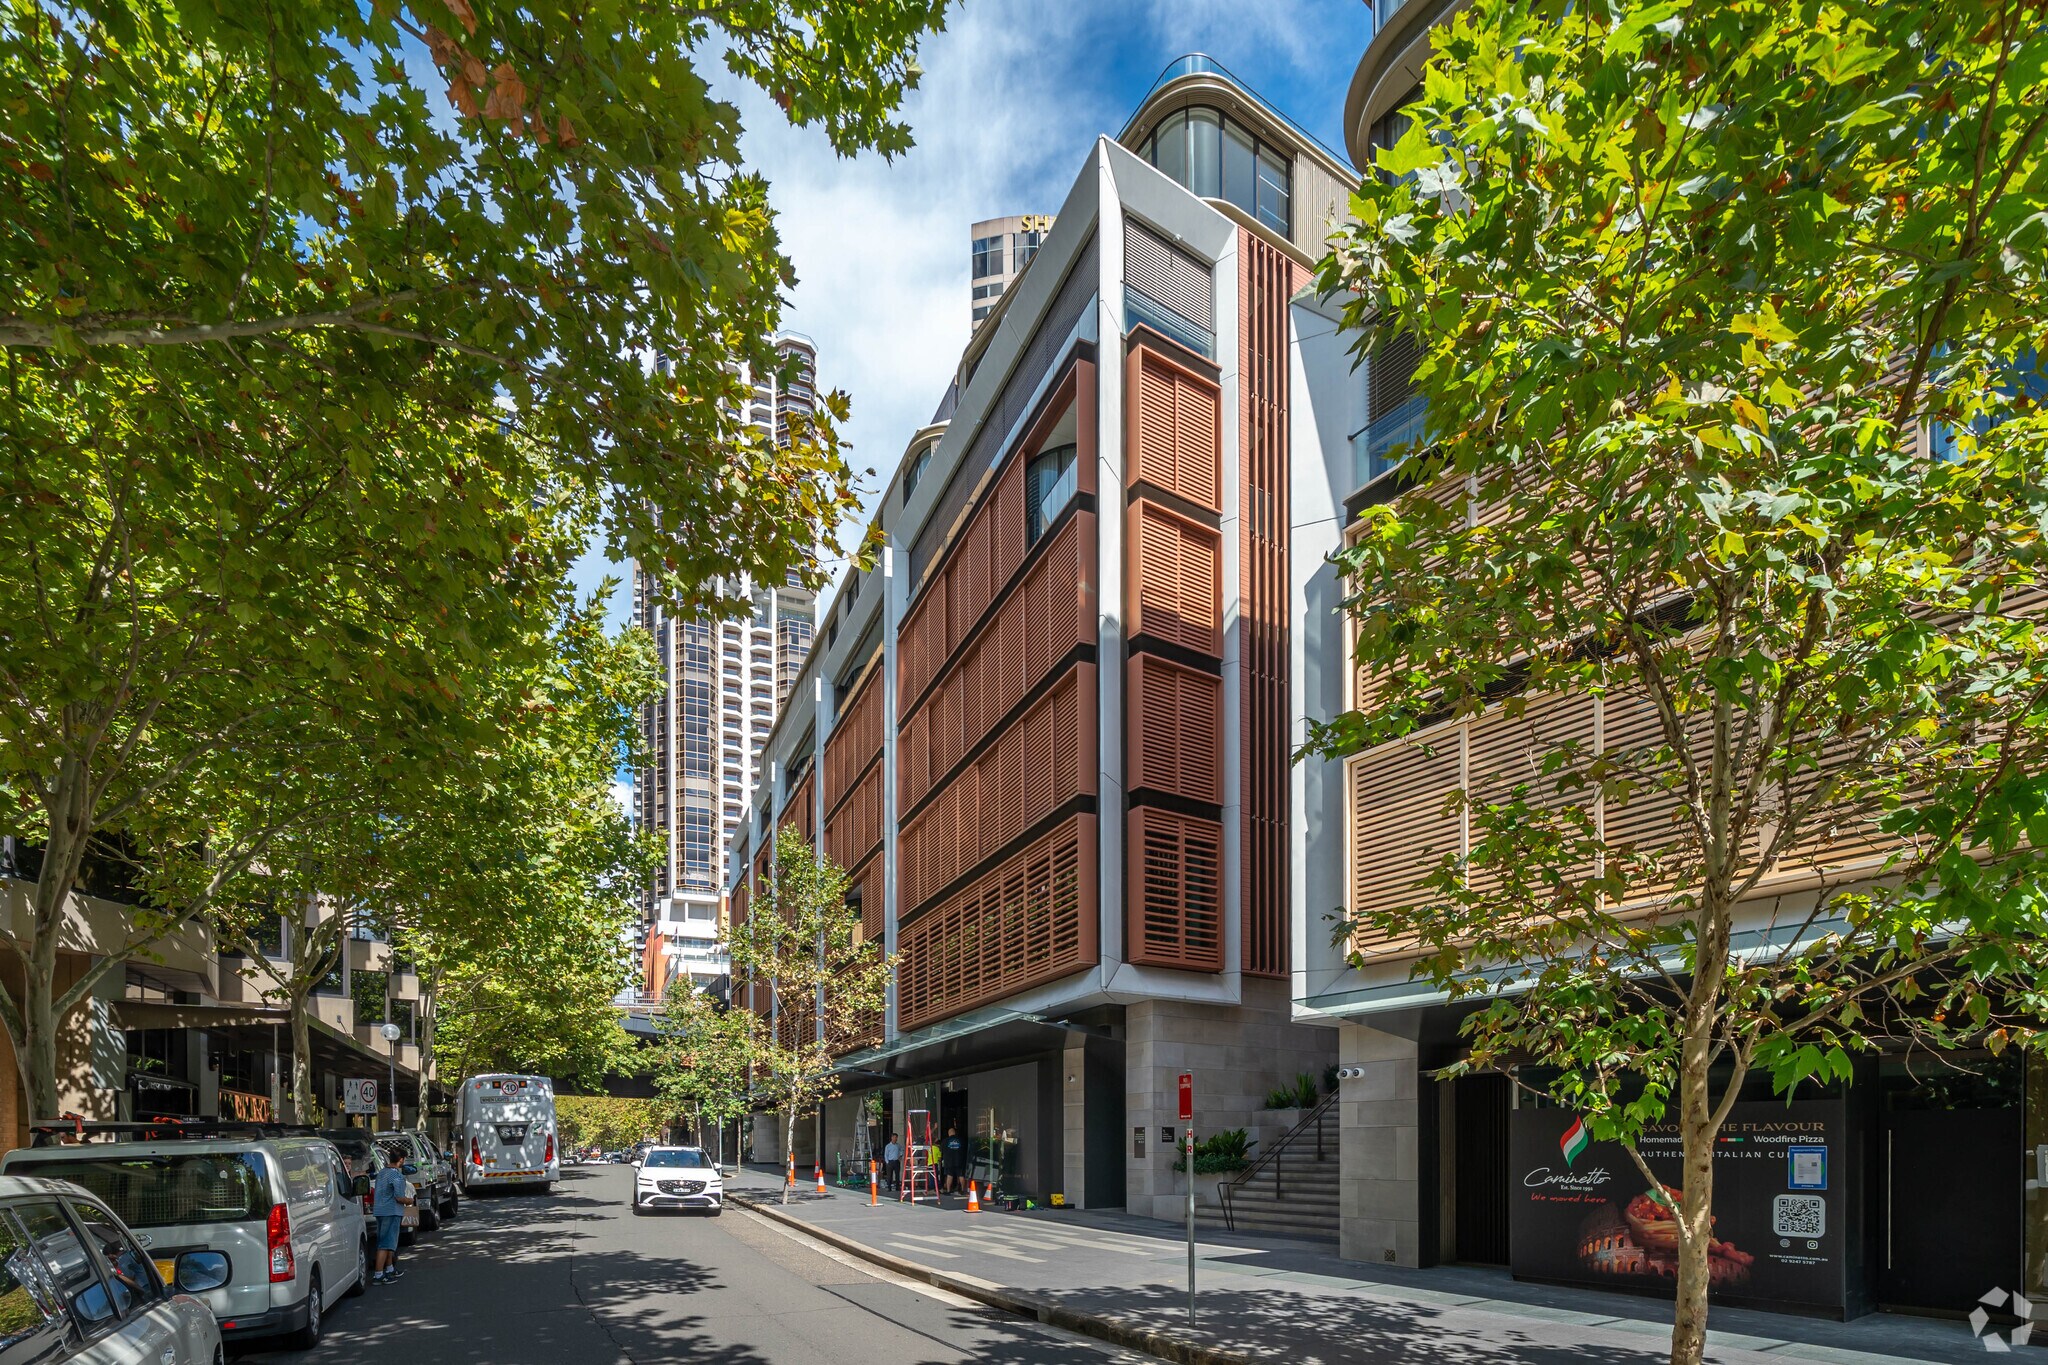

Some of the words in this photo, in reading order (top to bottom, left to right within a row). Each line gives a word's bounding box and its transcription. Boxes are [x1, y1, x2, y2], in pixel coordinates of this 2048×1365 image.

[363, 1087, 374, 1097] 40
[1641, 1124, 1680, 1133] SAVO
[1719, 1123, 1737, 1132] HE
[1742, 1122, 1825, 1132] FLAVOUR
[1753, 1135, 1797, 1143] Woodfire
[1798, 1135, 1824, 1143] Pizza
[1187, 1145, 1192, 1153] R
[1768, 1151, 1789, 1159] CUI
[1523, 1167, 1611, 1187] Caminetto
[1530, 1192, 1546, 1201] We
[1549, 1194, 1582, 1202] moved
[1584, 1194, 1606, 1203] here
